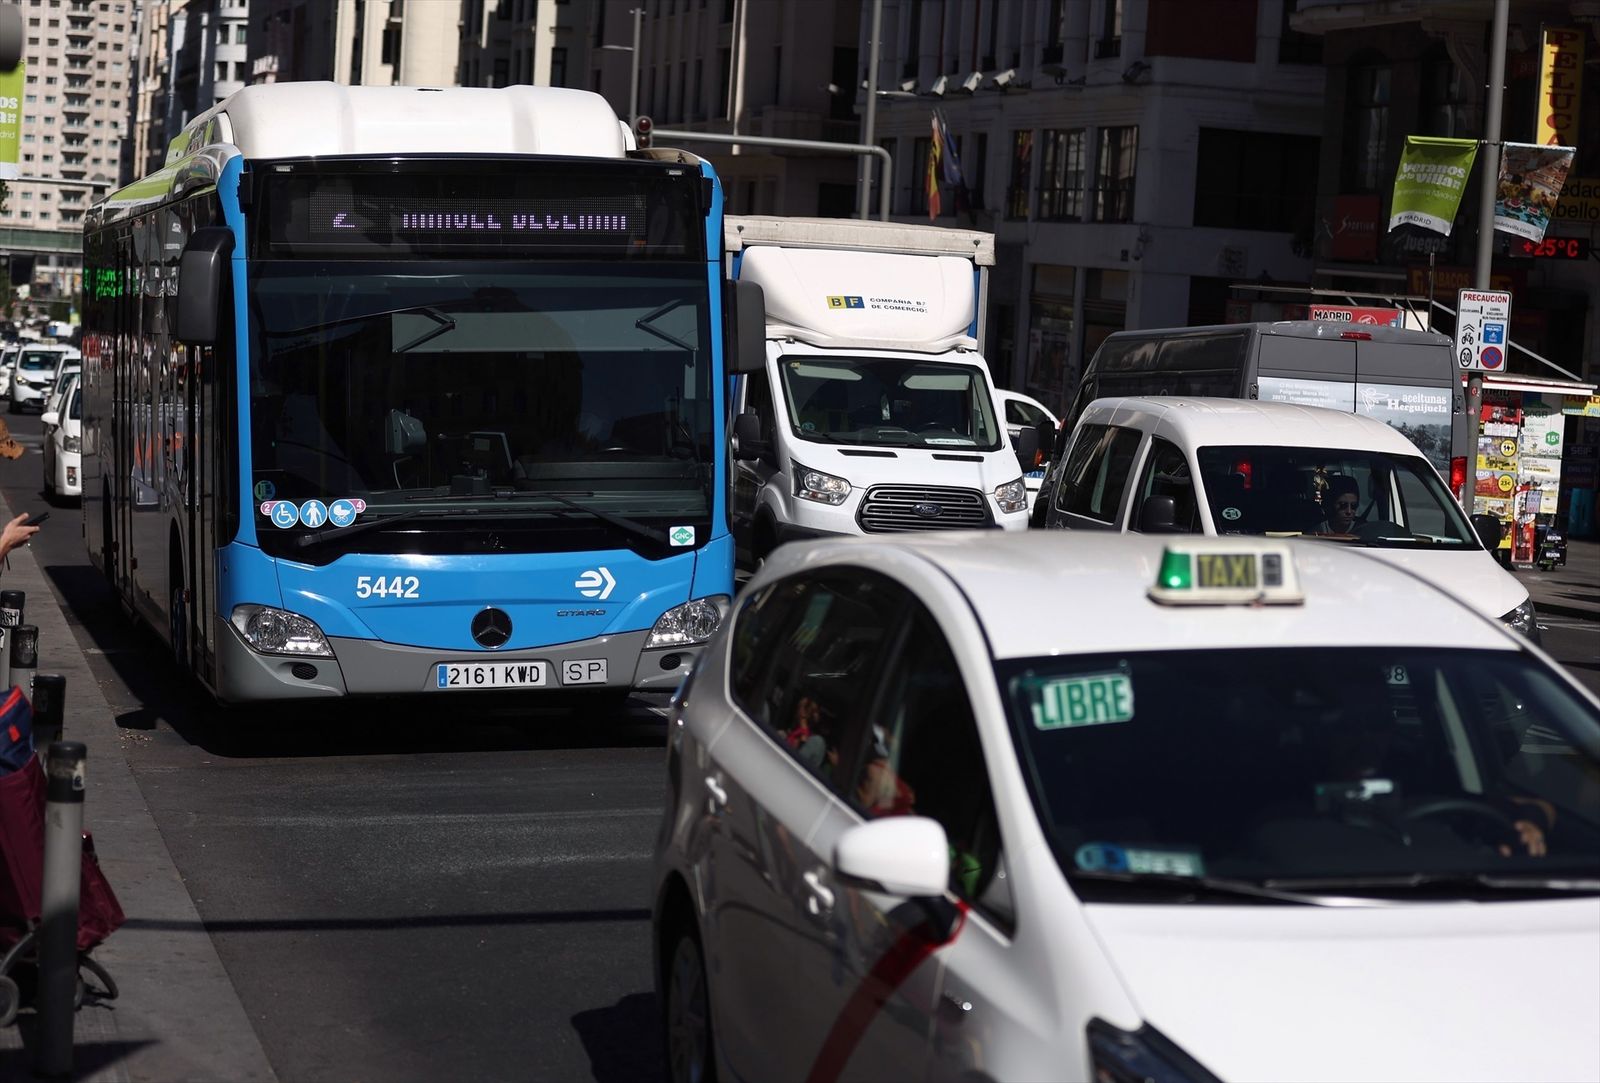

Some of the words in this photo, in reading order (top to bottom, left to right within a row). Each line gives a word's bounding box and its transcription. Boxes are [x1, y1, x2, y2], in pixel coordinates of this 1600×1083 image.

[1313, 309, 1353, 322] MADRID
[1402, 392, 1447, 404] aceitunas
[1387, 398, 1447, 414] Herguijuela
[264, 503, 270, 511] 2
[355, 501, 362, 509] 4
[674, 532, 690, 540] GNC
[1199, 555, 1256, 586] TAXI
[356, 576, 420, 598] 5442
[556, 609, 607, 617] CITARO
[449, 667, 496, 685] 2161
[505, 665, 541, 684] KWD
[1036, 679, 1130, 726] LIBRE
